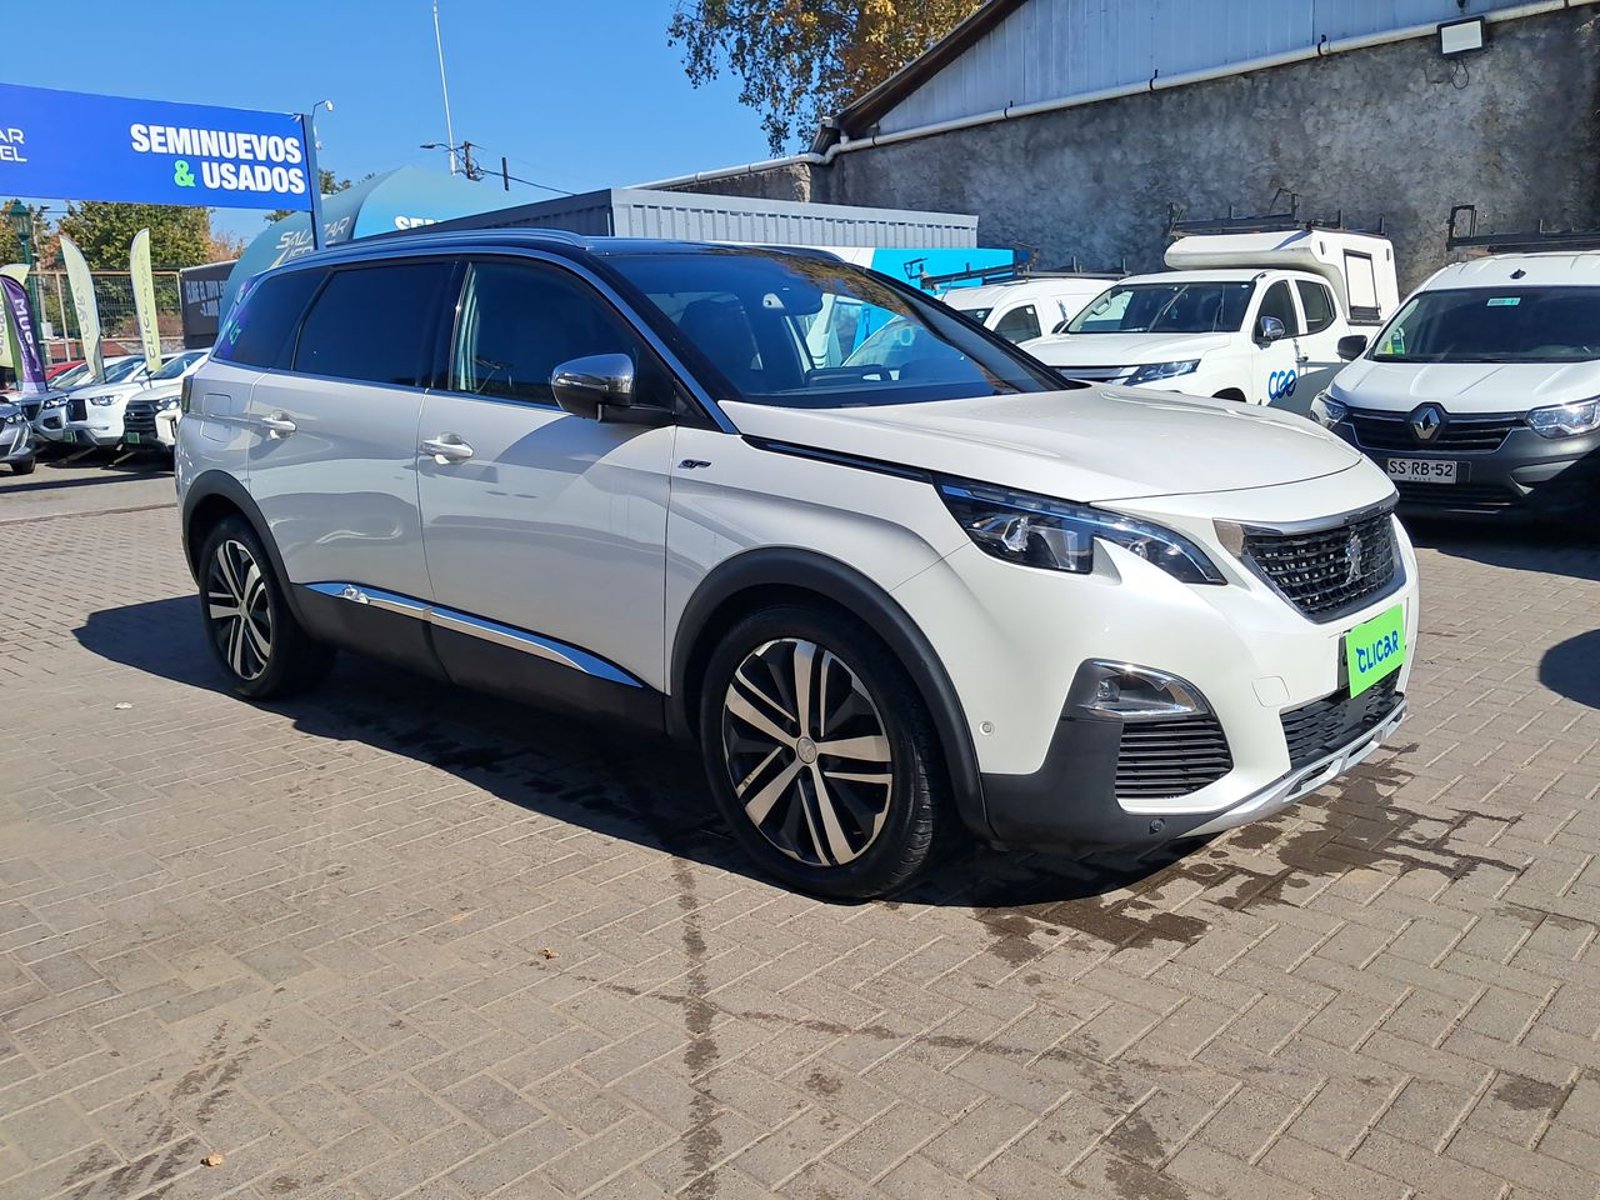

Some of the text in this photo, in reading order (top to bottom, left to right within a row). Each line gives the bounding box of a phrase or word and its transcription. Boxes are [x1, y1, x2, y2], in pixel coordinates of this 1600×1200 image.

[130, 123, 302, 164] SEMINUEVOS
[174, 159, 305, 194] & USADOS
